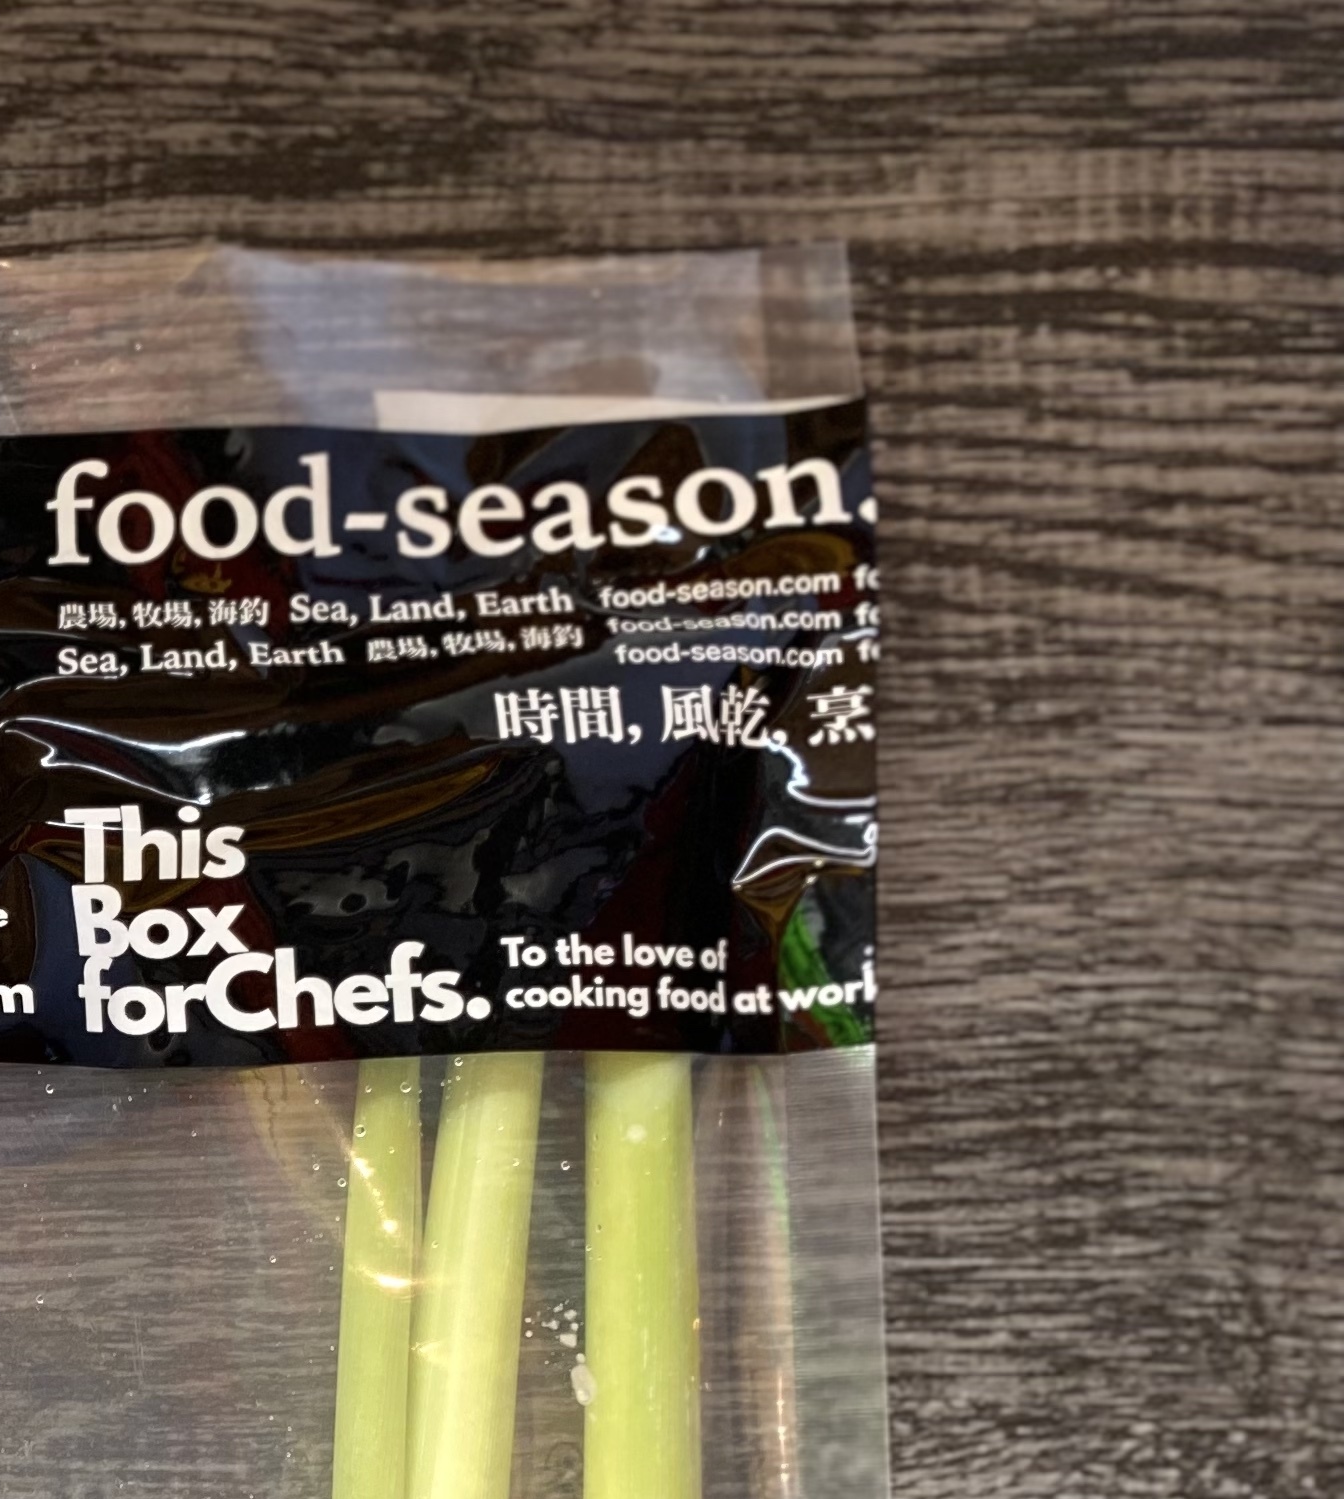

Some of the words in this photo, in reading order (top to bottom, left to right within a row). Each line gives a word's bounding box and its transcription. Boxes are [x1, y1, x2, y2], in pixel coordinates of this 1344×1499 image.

[290, 594, 358, 627] Sea,
[369, 593, 466, 622] Land,
[475, 586, 574, 616] Earth
[599, 573, 840, 608] food-season.com
[606, 611, 841, 634] food-season.com
[57, 647, 129, 677] Sea,
[140, 643, 238, 673] Land,
[247, 640, 345, 666] Earth
[614, 642, 844, 668] food-season.com
[494, 685, 642, 745] 時間,
[660, 684, 788, 748] 風乾,
[806, 685, 875, 746] 烹
[64, 805, 247, 884] This
[72, 884, 249, 959] Box
[500, 936, 547, 967] To
[554, 933, 615, 966] the
[623, 933, 694, 968] love
[700, 939, 727, 971] of
[505, 975, 649, 1018] cooking
[656, 975, 726, 1013] food
[733, 985, 772, 1014] at
